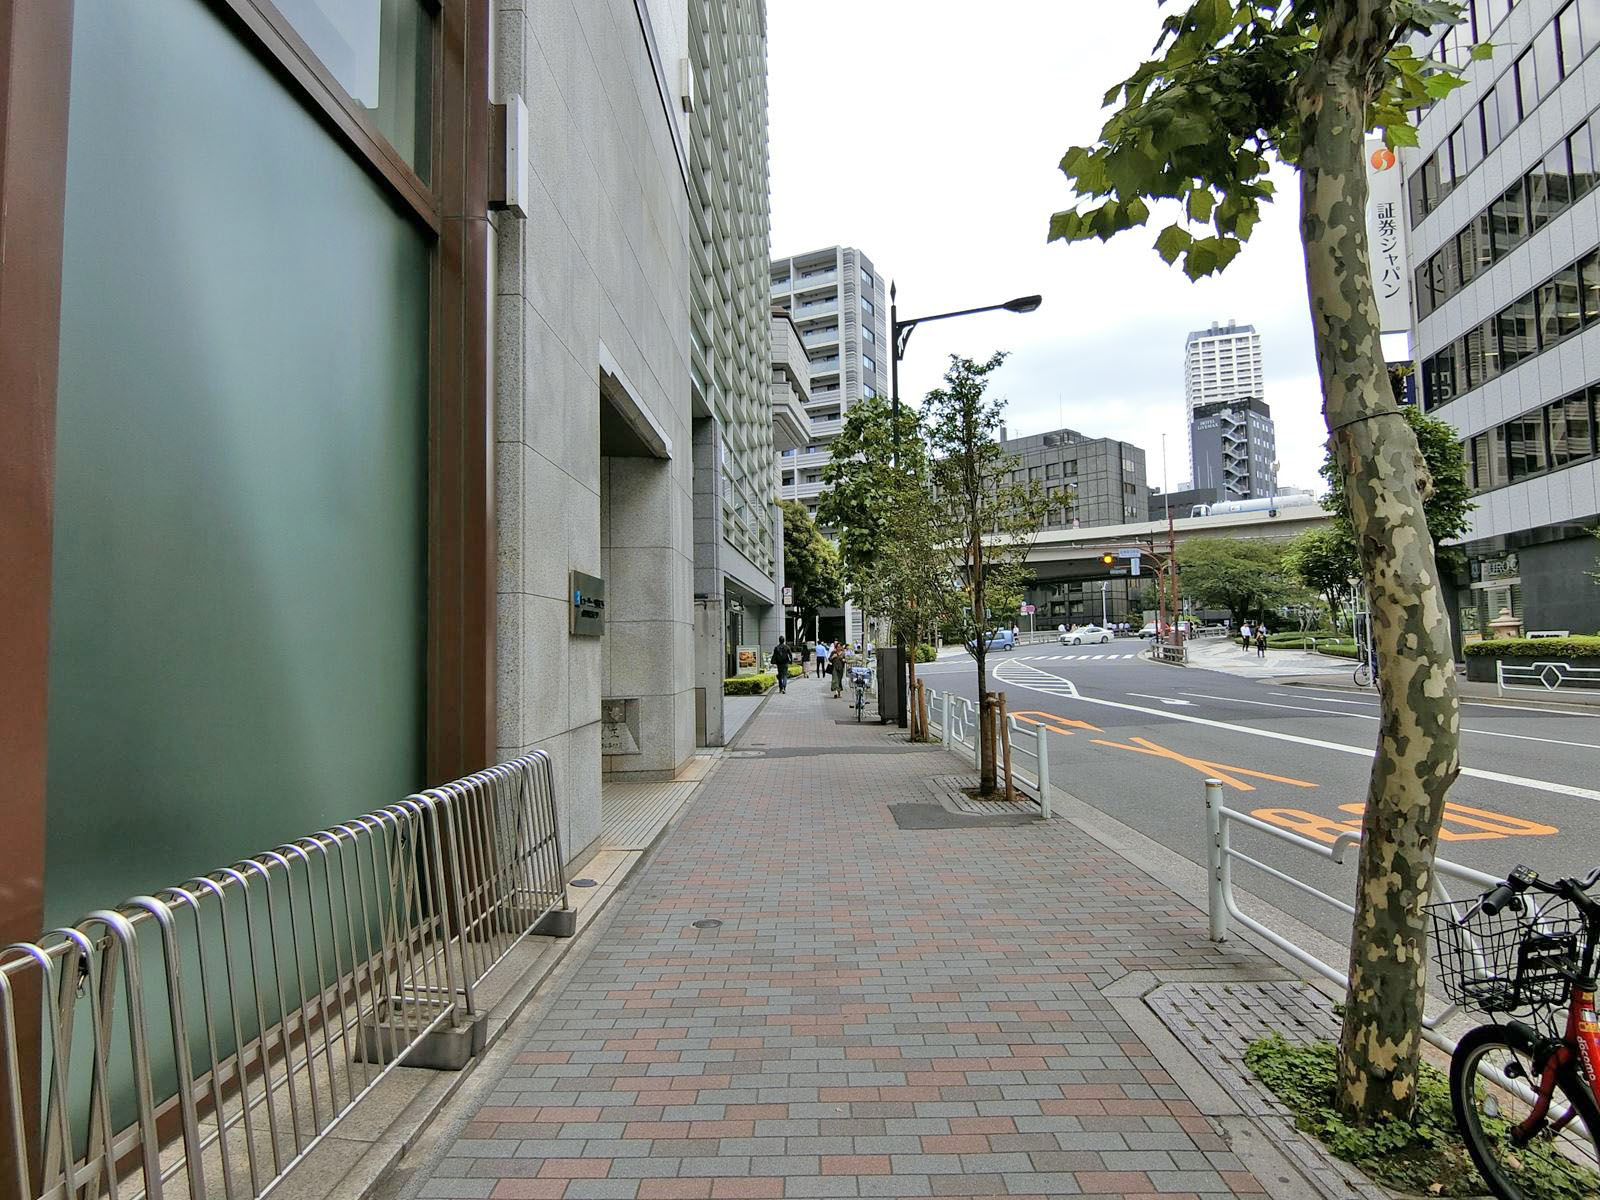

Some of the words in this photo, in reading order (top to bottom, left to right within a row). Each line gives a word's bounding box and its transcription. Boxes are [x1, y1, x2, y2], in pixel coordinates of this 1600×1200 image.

[1377, 202, 1400, 299] 証券ジャパン
[1577, 1035, 1596, 1081] docomo
